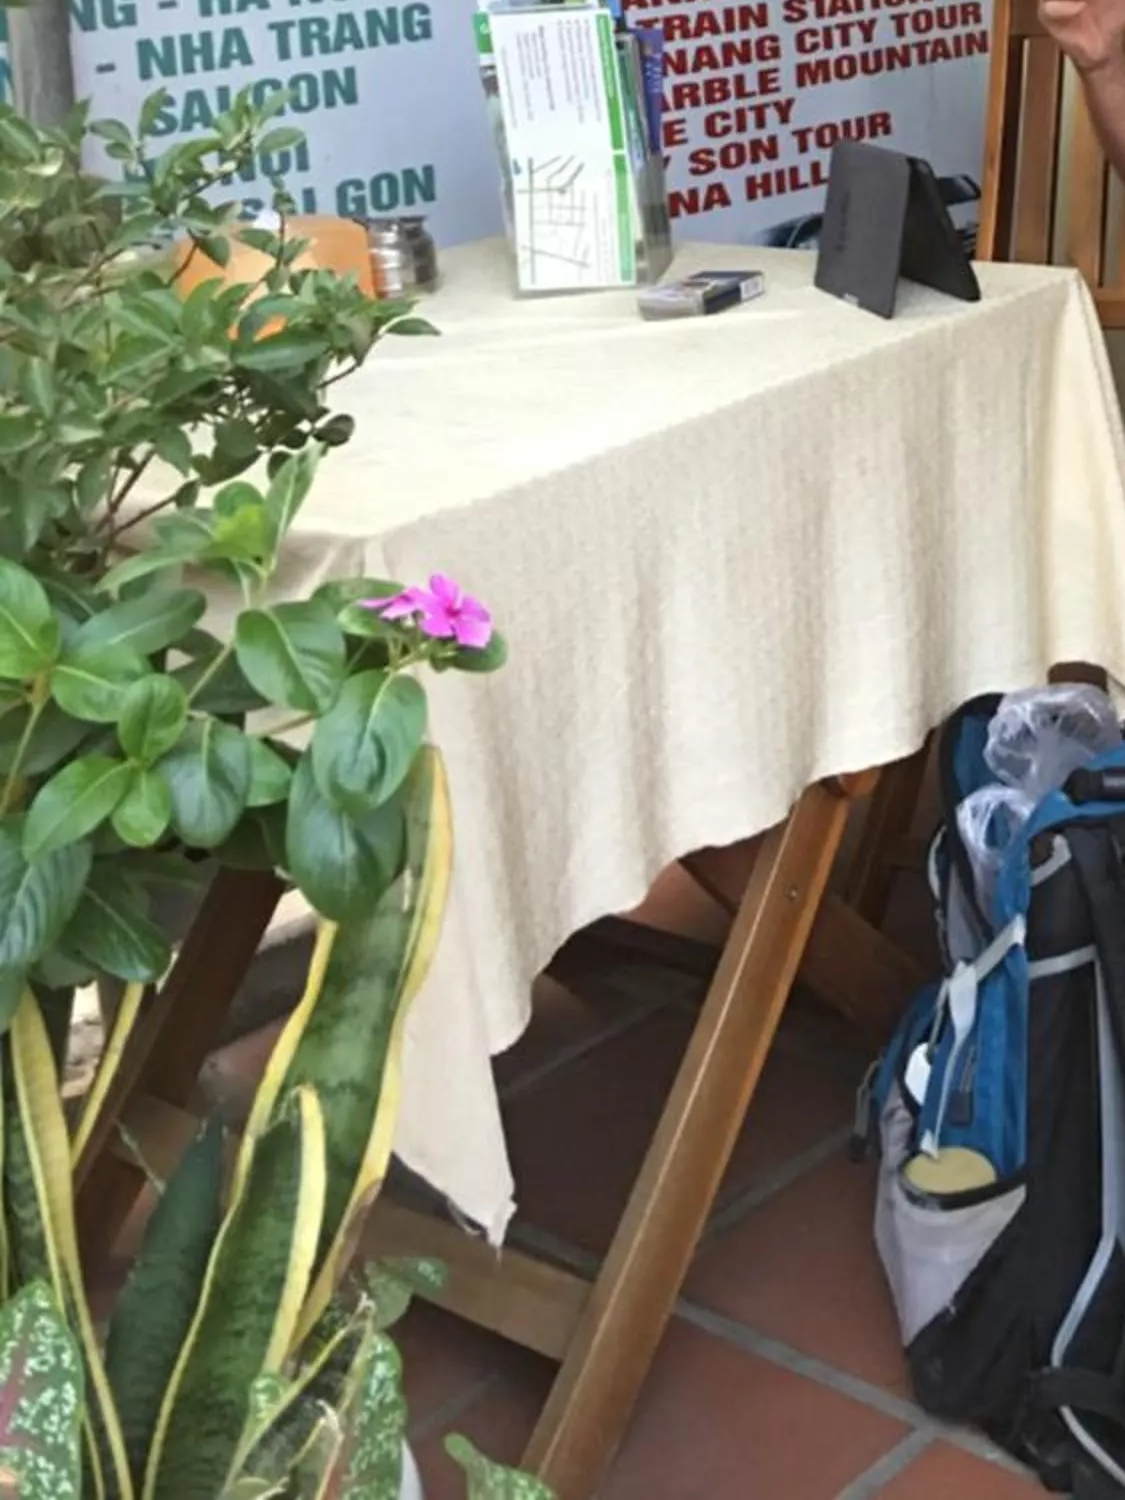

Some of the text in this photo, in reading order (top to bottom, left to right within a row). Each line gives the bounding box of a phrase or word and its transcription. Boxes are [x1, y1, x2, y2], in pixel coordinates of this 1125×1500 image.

[137, 27, 254, 80] NHA
[268, 3, 433, 62] TRANG
[662, 34, 781, 77] NANG
[795, 18, 878, 54] CITY
[889, 1, 982, 38] TOUR
[795, 30, 989, 89] MOUNTAIN
[689, 112, 892, 176] SON TOUR
[704, 98, 796, 138] CITY
